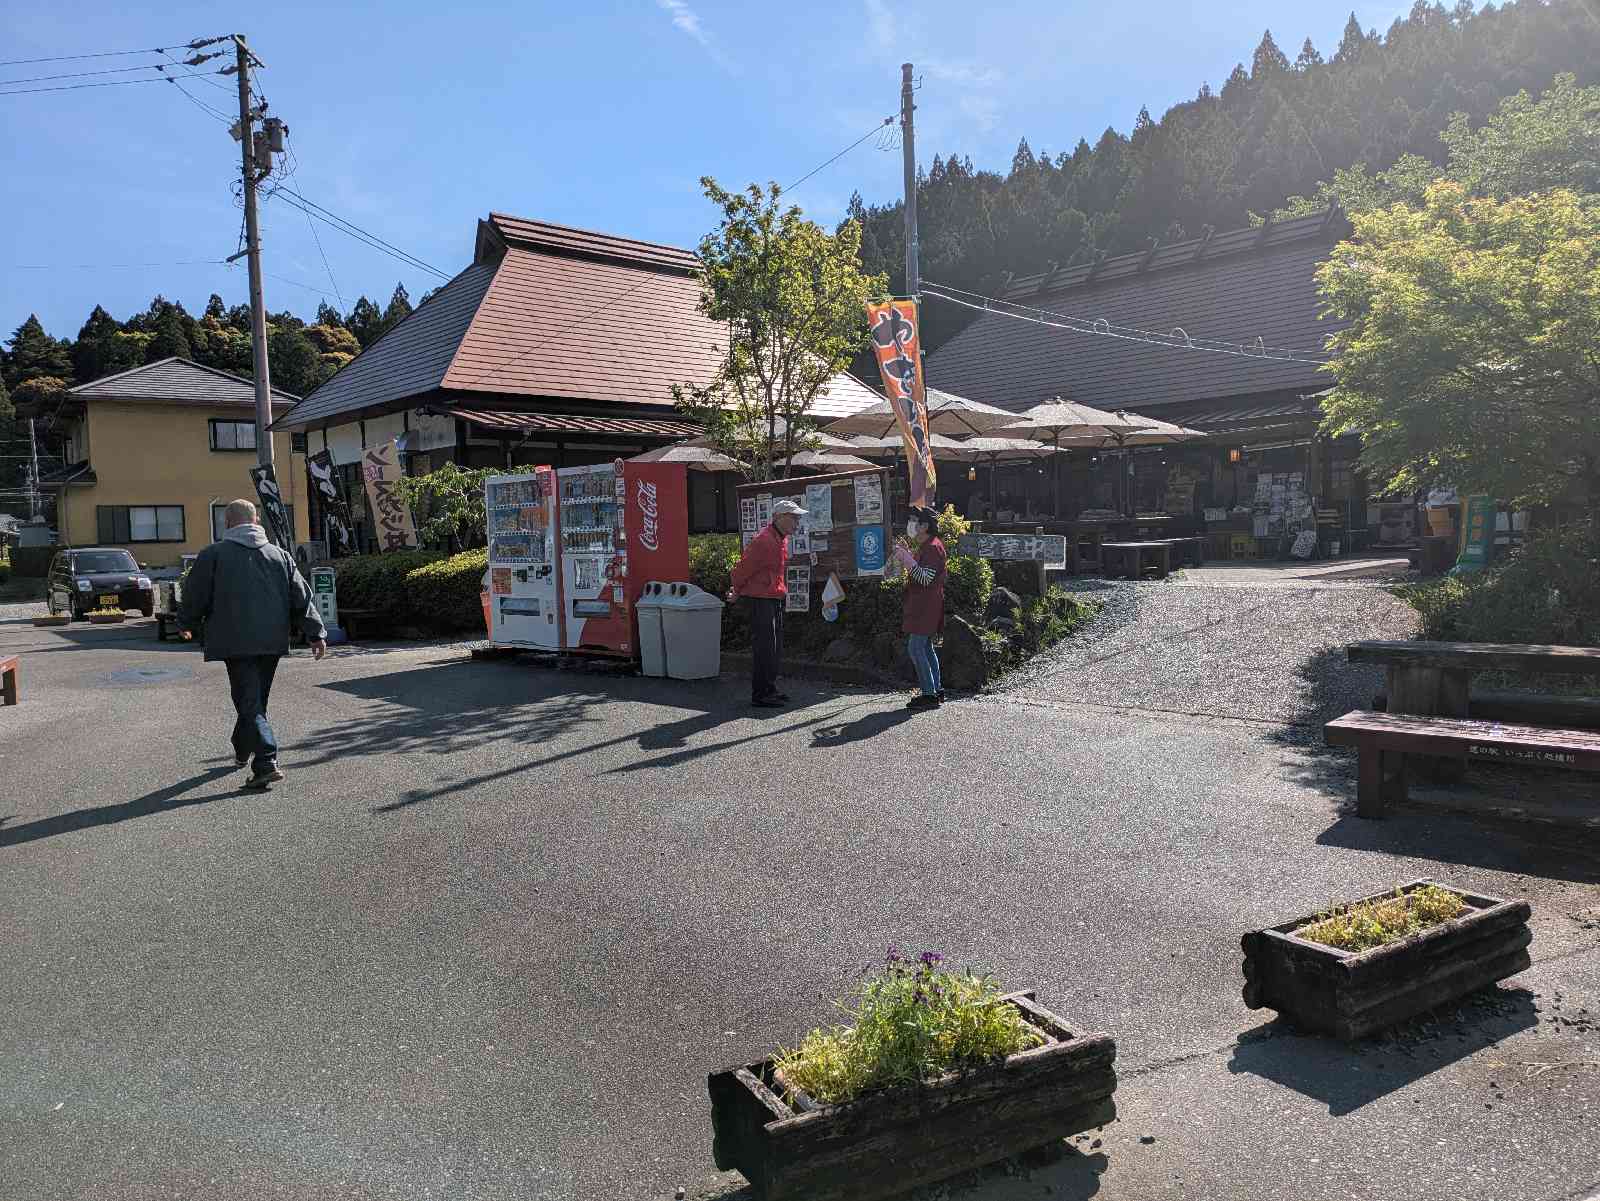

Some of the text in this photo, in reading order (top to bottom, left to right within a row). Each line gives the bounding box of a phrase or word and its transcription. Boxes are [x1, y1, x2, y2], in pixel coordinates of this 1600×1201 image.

[977, 535, 1046, 560] 営業中
[1469, 744, 1500, 756] 道の駅
